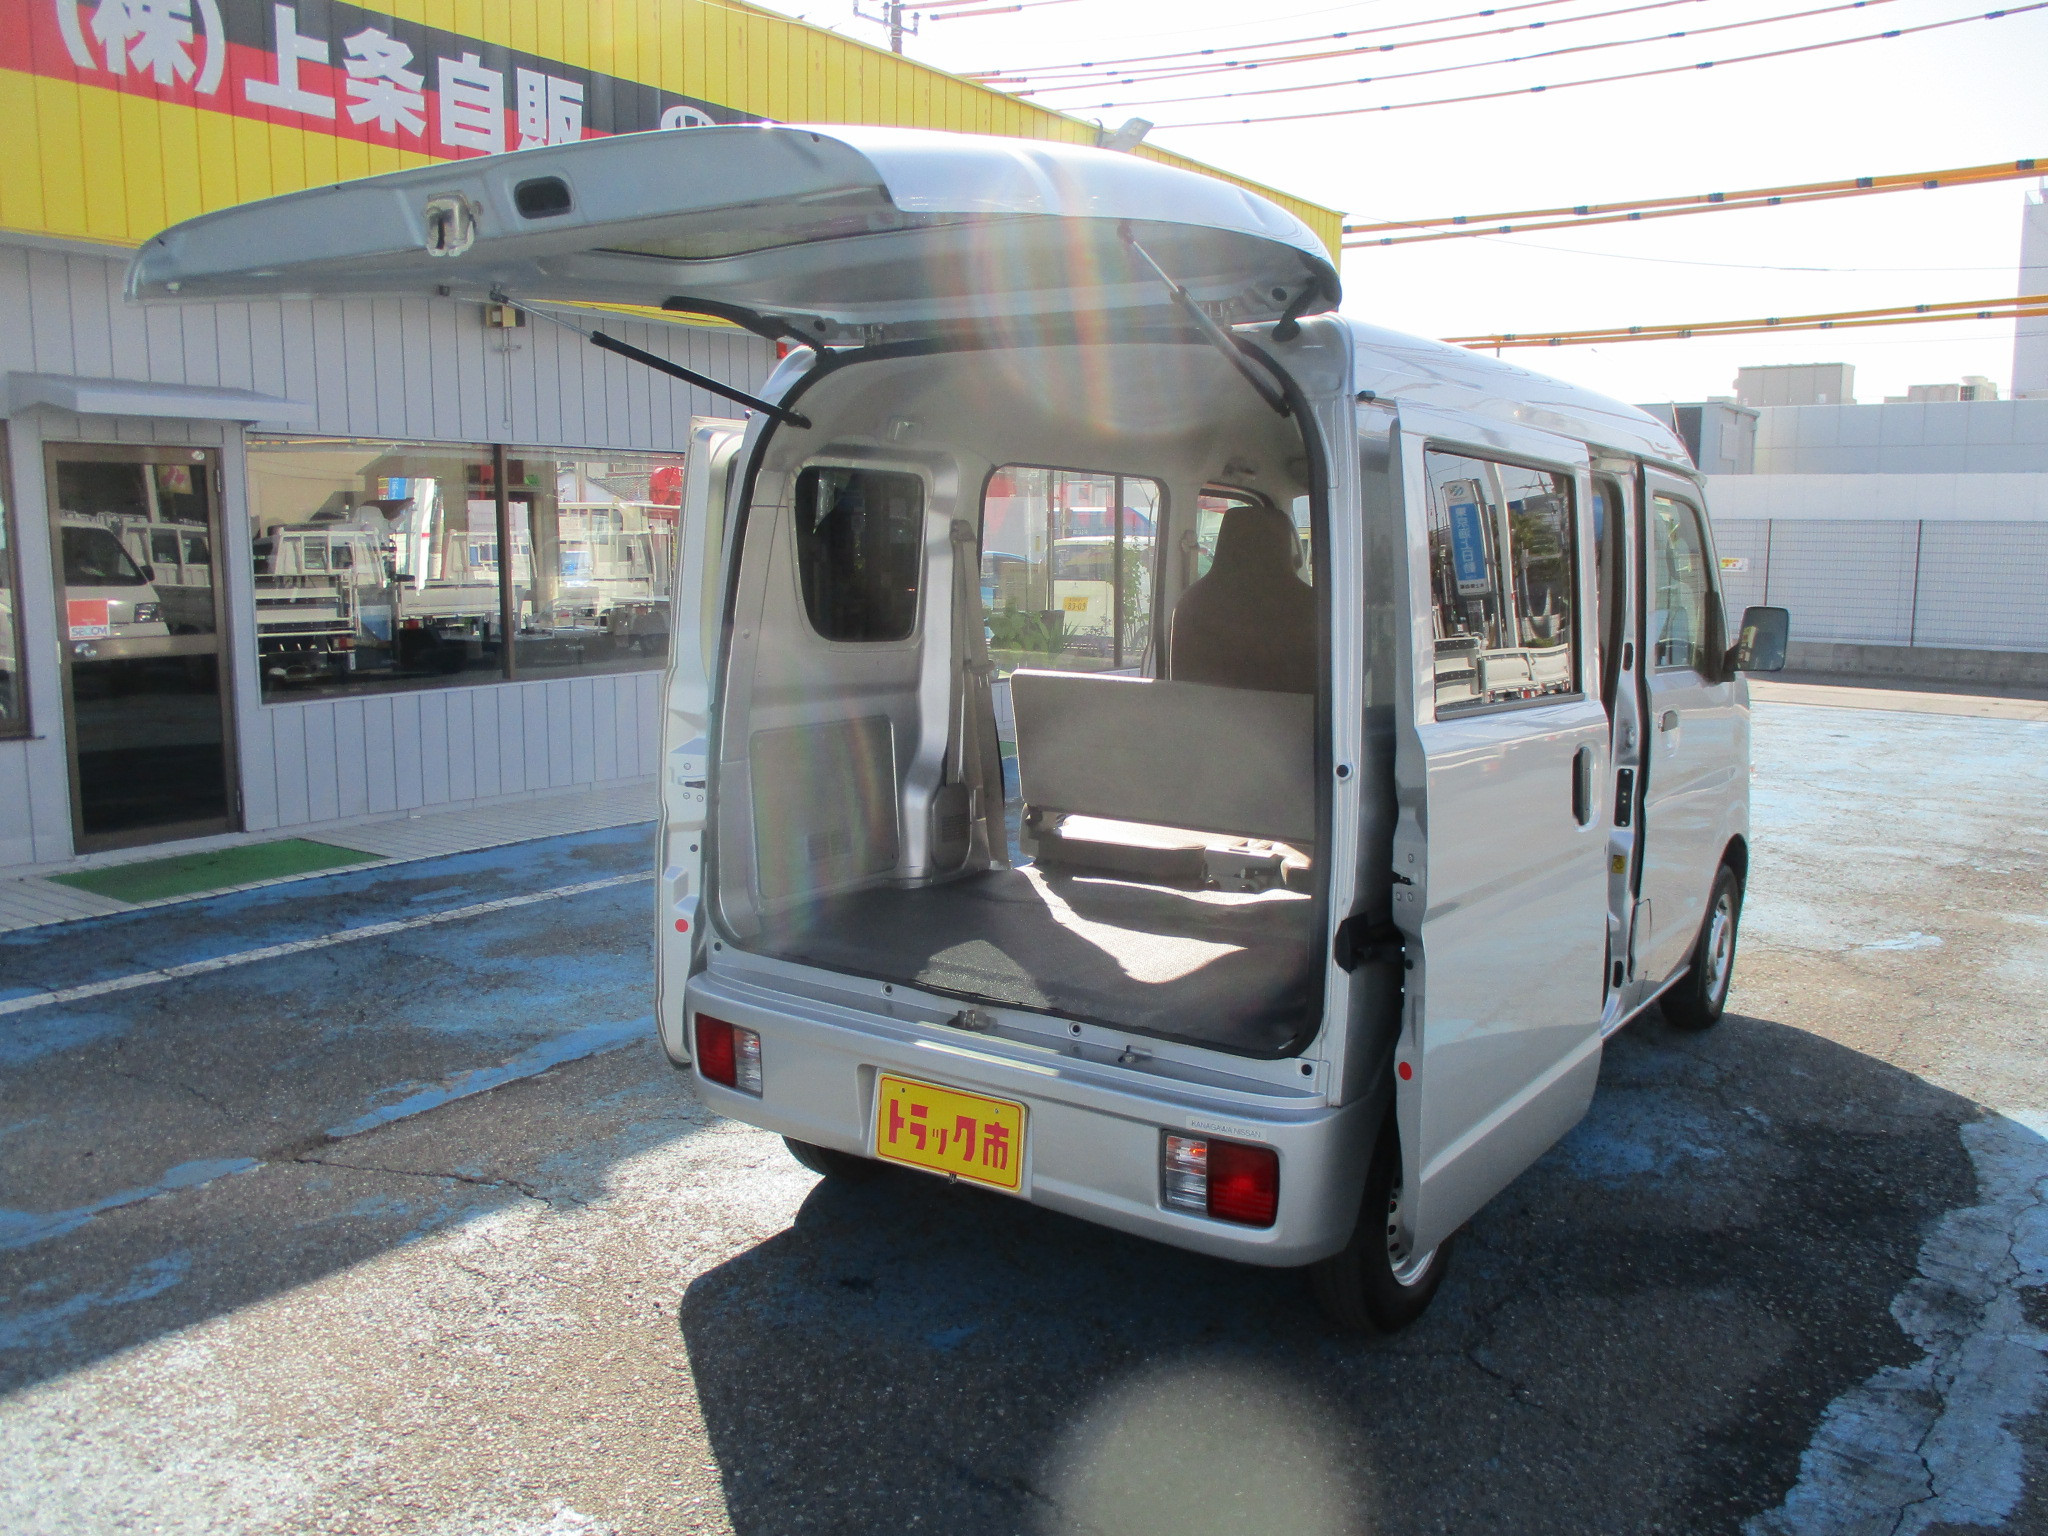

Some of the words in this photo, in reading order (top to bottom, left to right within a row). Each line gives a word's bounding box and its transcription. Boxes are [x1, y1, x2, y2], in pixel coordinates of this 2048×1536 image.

[71, 626, 107, 637] SECOM
[888, 1098, 1010, 1170] トラック市
[1191, 1119, 1233, 1134] KANAGAWA
[1233, 1128, 1262, 1138] NISSAN
